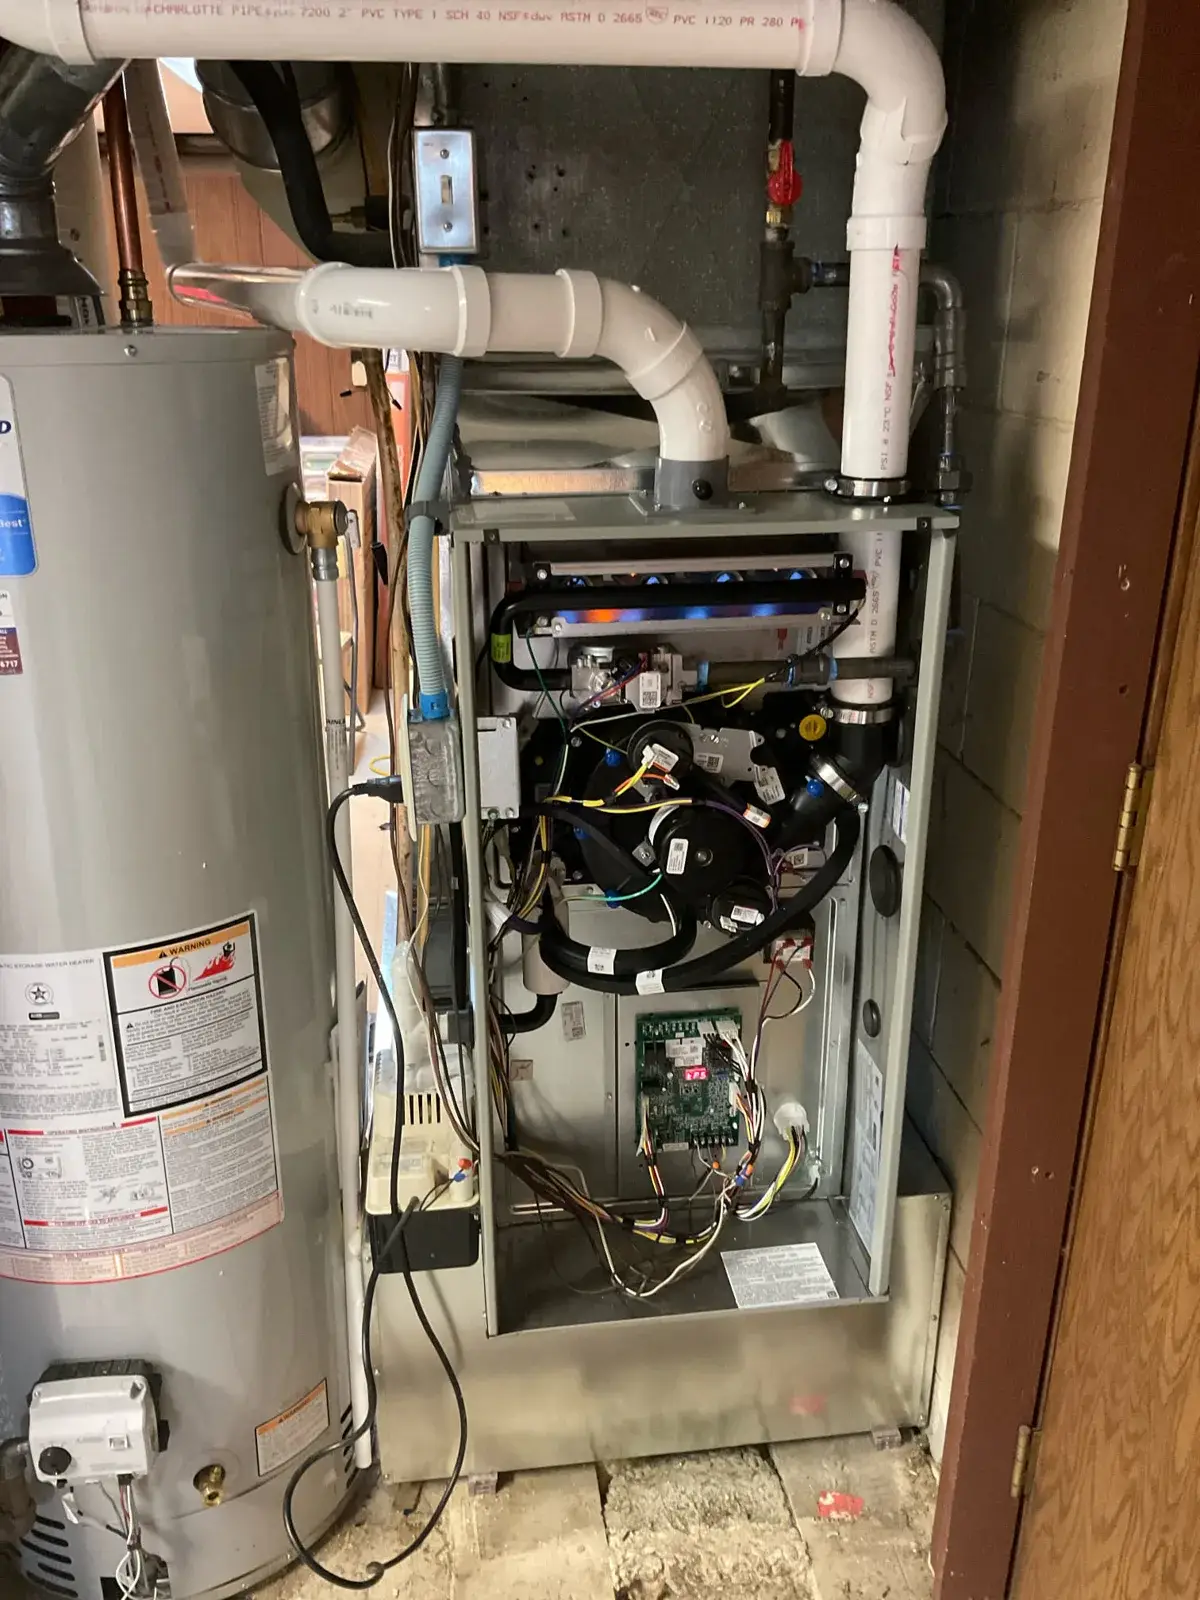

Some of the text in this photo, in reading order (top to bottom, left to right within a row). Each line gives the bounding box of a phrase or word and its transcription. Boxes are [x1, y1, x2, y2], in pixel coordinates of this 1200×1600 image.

[361, 8, 385, 19] PVC
[393, 9, 423, 20] TYPE
[446, 10, 469, 20] SCH
[476, 10, 491, 20] 40
[560, 12, 591, 22] ASTM
[673, 14, 696, 25] PVC
[704, 16, 733, 26] 1120
[739, 16, 755, 27] PR
[762, 17, 784, 27] 280
[879, 452, 888, 471] PSI
[874, 548, 882, 567] PVC
[169, 938, 211, 955] WARNING
